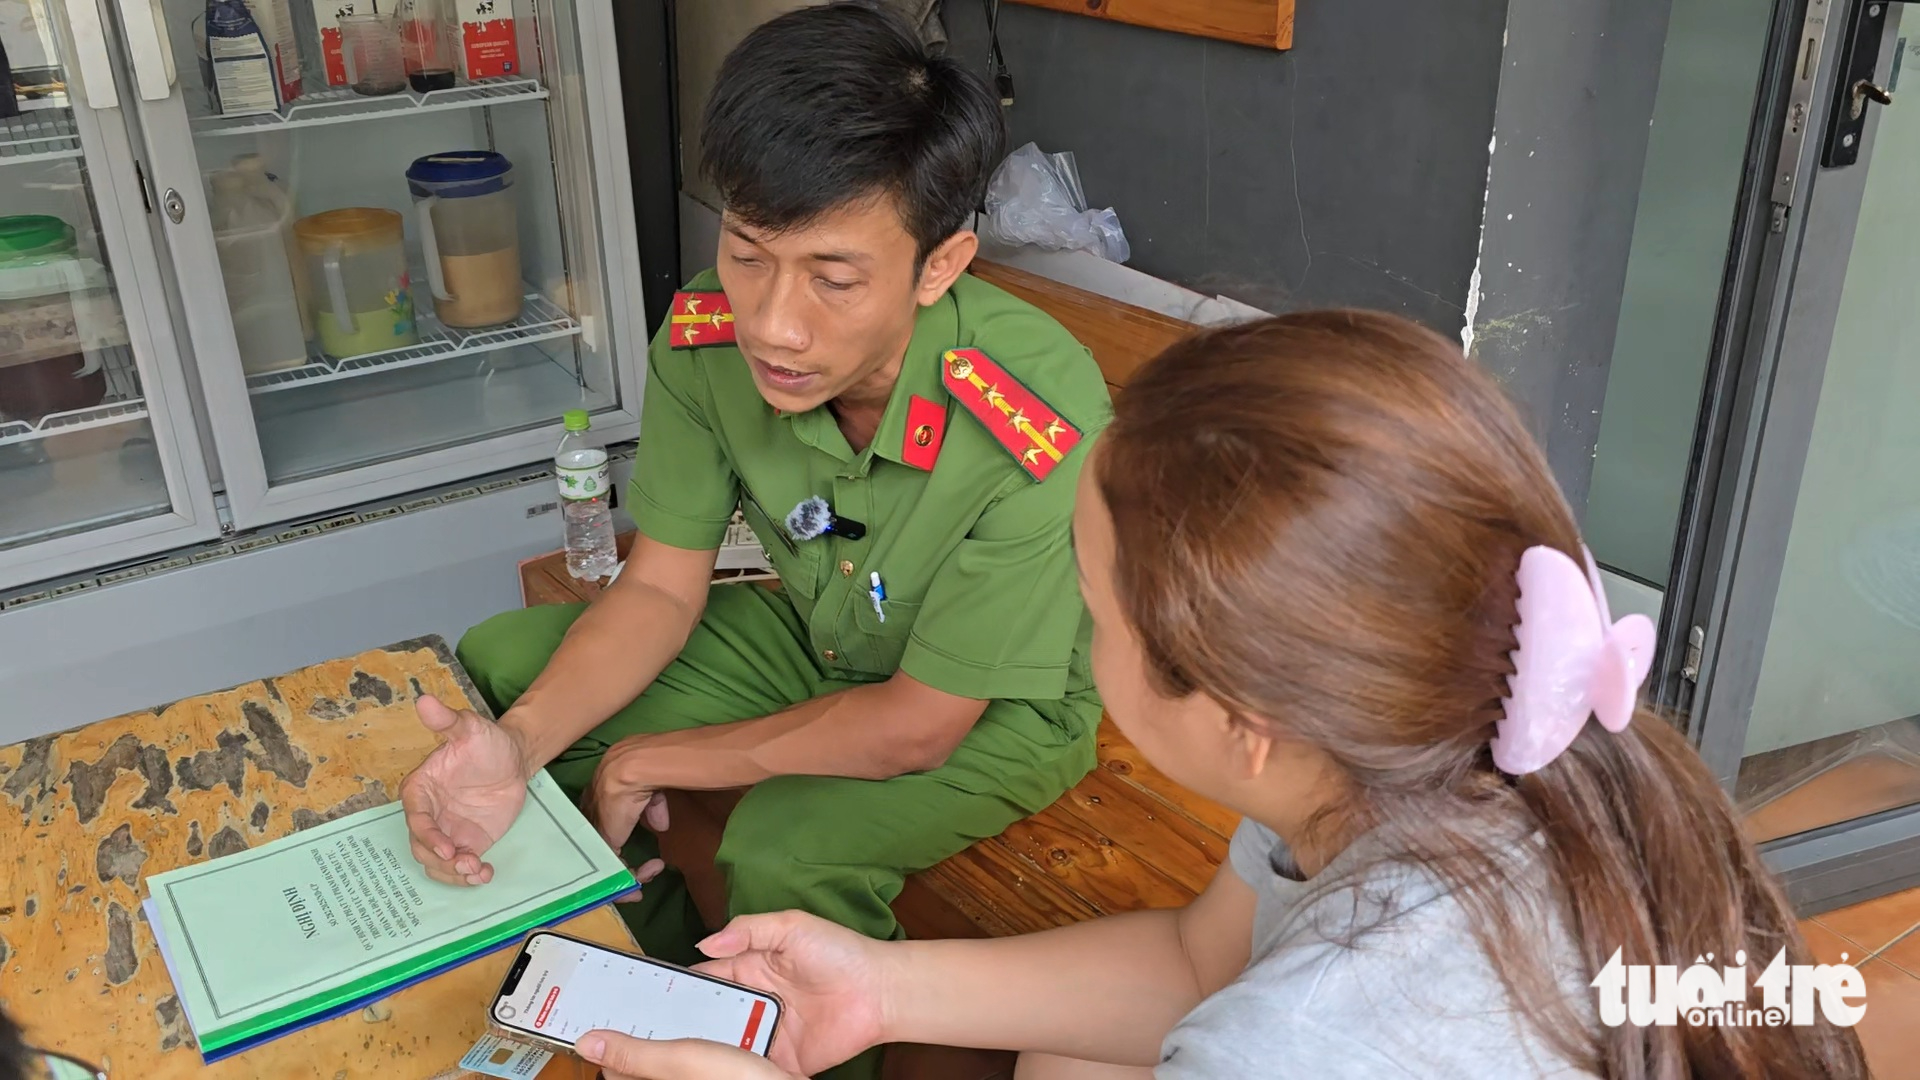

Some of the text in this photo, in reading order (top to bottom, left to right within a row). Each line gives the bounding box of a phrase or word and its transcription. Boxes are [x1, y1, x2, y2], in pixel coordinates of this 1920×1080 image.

[282, 885, 323, 939] NGHỊ ĐỊNH
[339, 900, 355, 917] PHẠT
